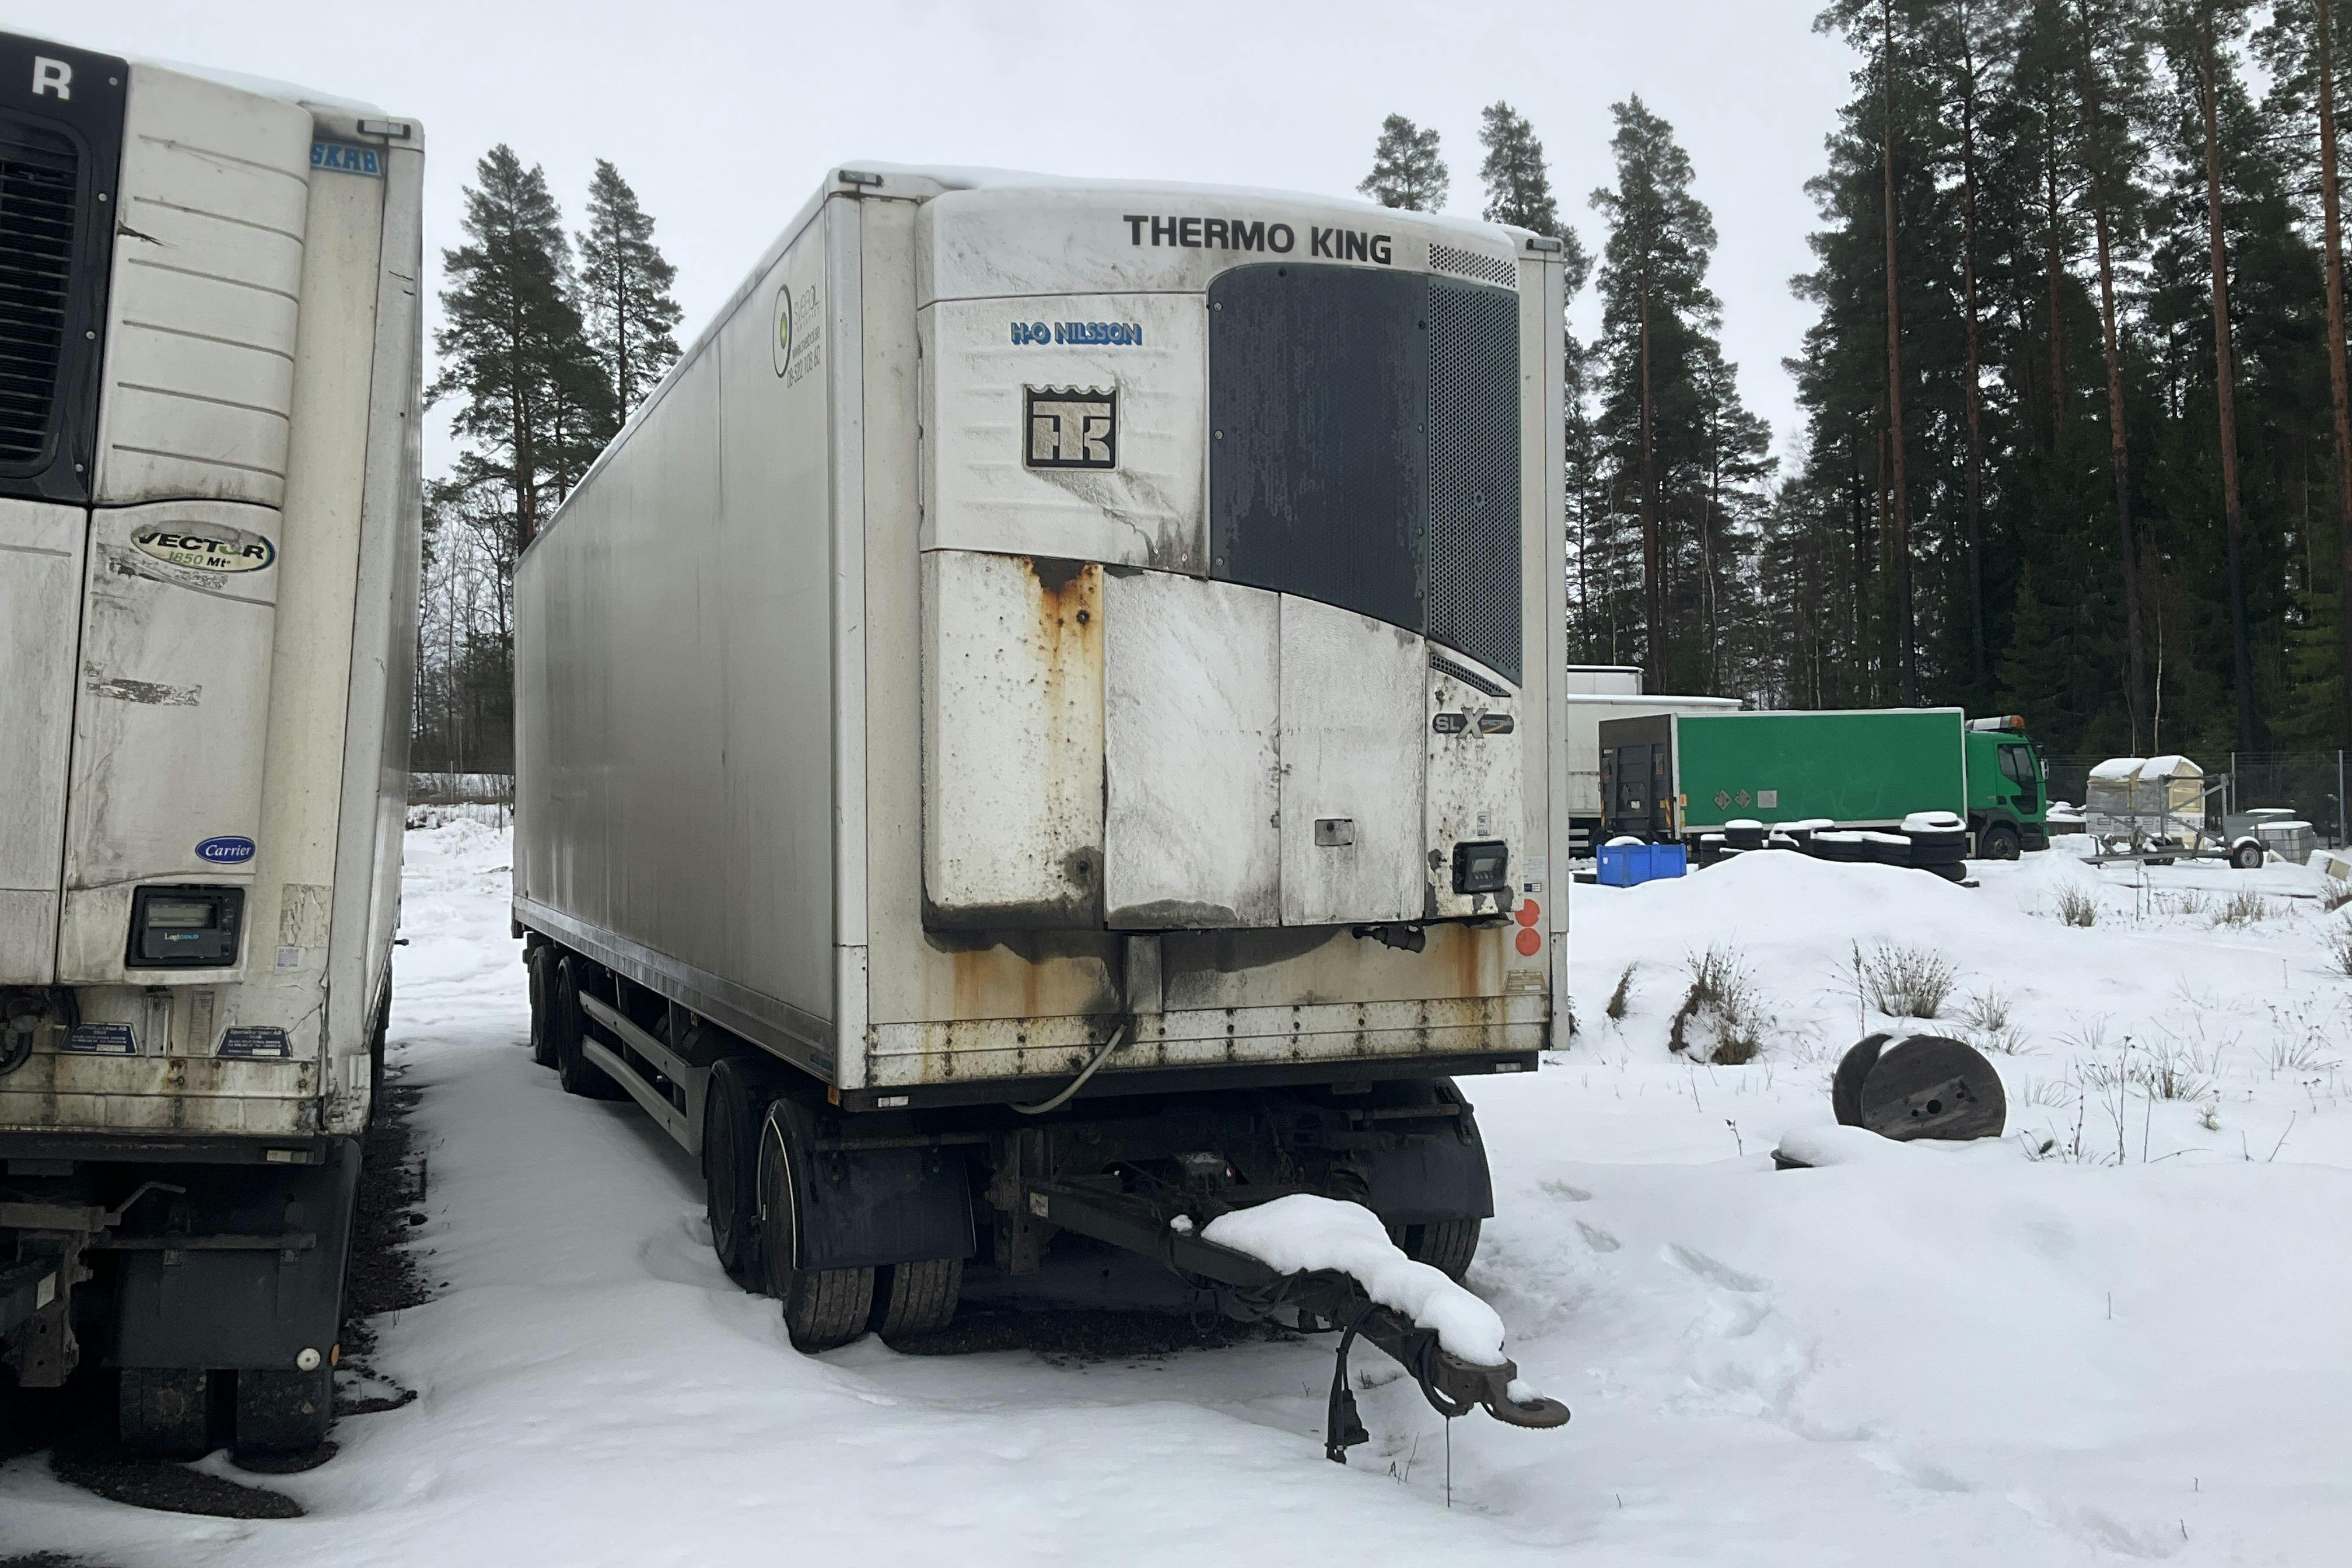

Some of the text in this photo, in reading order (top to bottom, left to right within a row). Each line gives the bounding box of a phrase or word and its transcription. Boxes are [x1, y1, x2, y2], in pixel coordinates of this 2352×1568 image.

[32, 55, 72, 100] R
[310, 144, 378, 173] SKAB
[1123, 214, 1392, 265] THERMO KING
[1011, 321, 1142, 346] H-O NILSSON
[169, 551, 204, 565] 1850
[205, 844, 251, 856] Carrier
